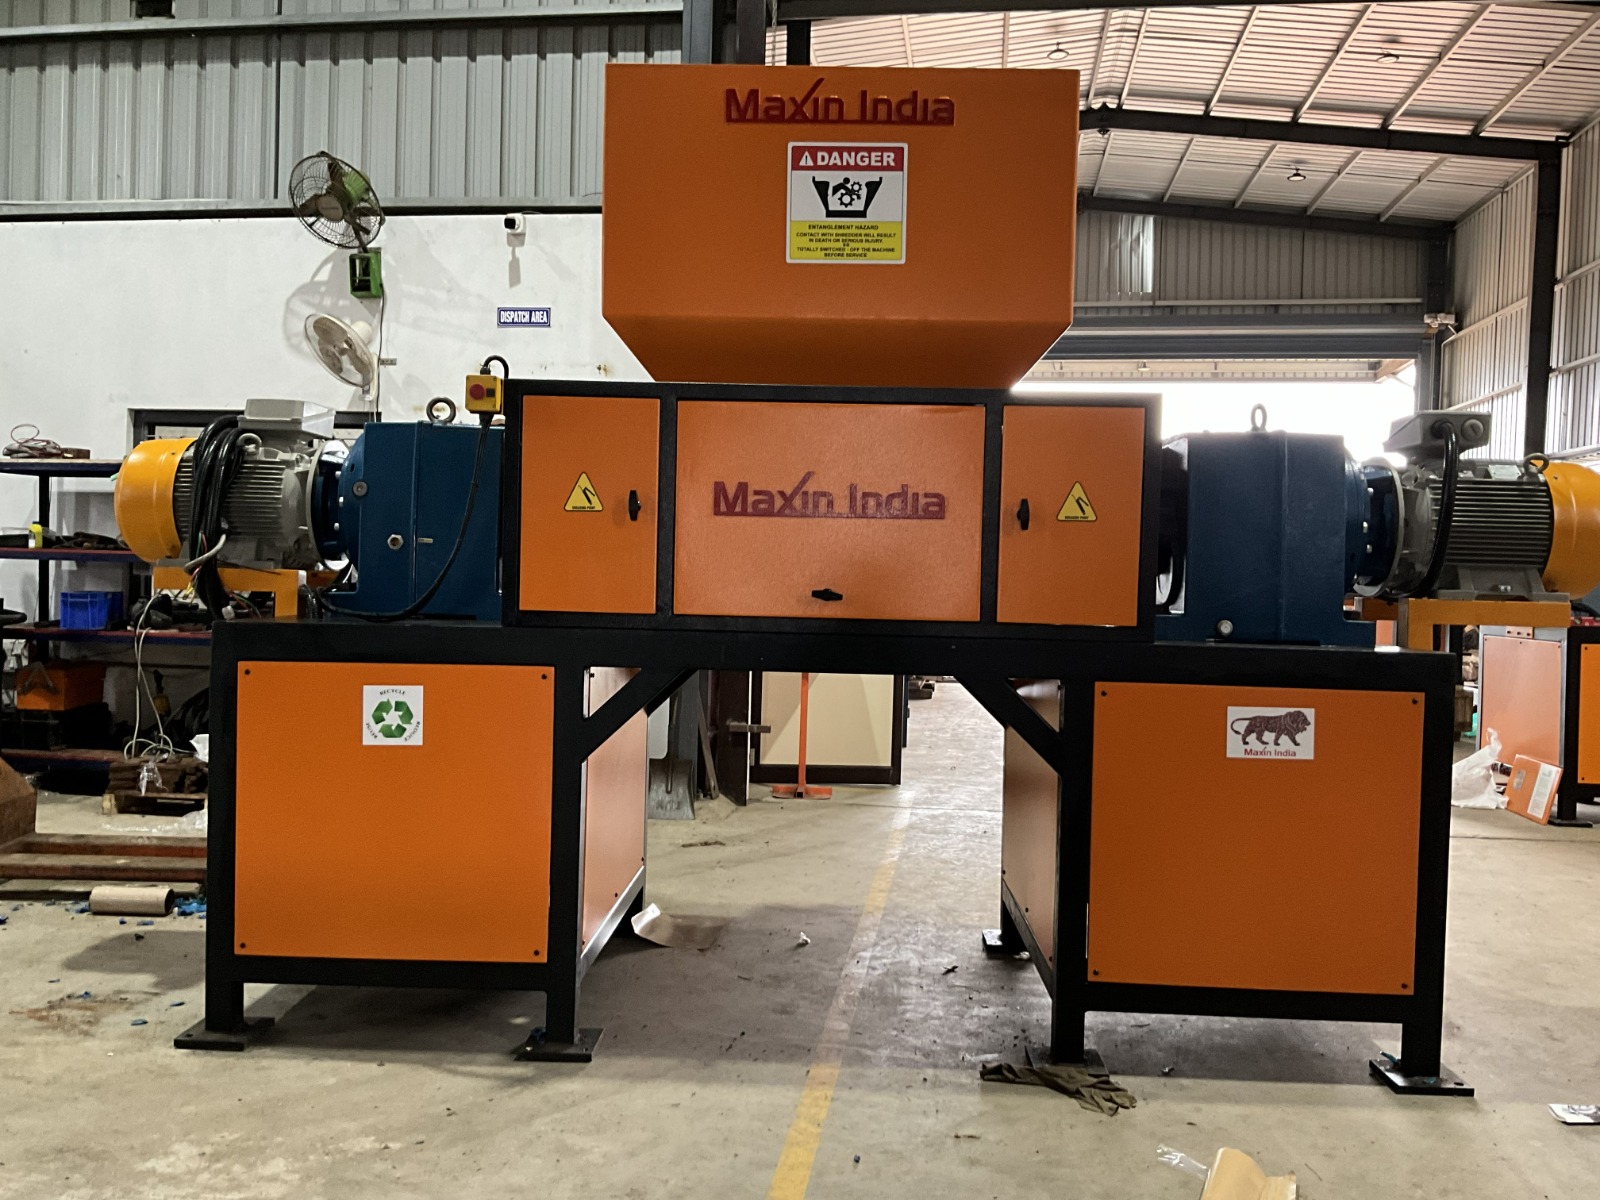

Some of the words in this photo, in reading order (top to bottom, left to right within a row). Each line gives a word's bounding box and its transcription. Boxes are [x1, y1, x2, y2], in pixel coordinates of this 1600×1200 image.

[725, 77, 844, 125] Maxin
[860, 89, 955, 127] India
[817, 151, 895, 167] DANGER
[500, 310, 530, 323] DISPATCH
[531, 310, 547, 323] AREA
[713, 470, 834, 516] Maxin
[849, 483, 946, 520] India
[1244, 746, 1272, 757] Maxin
[1274, 749, 1297, 757] India
